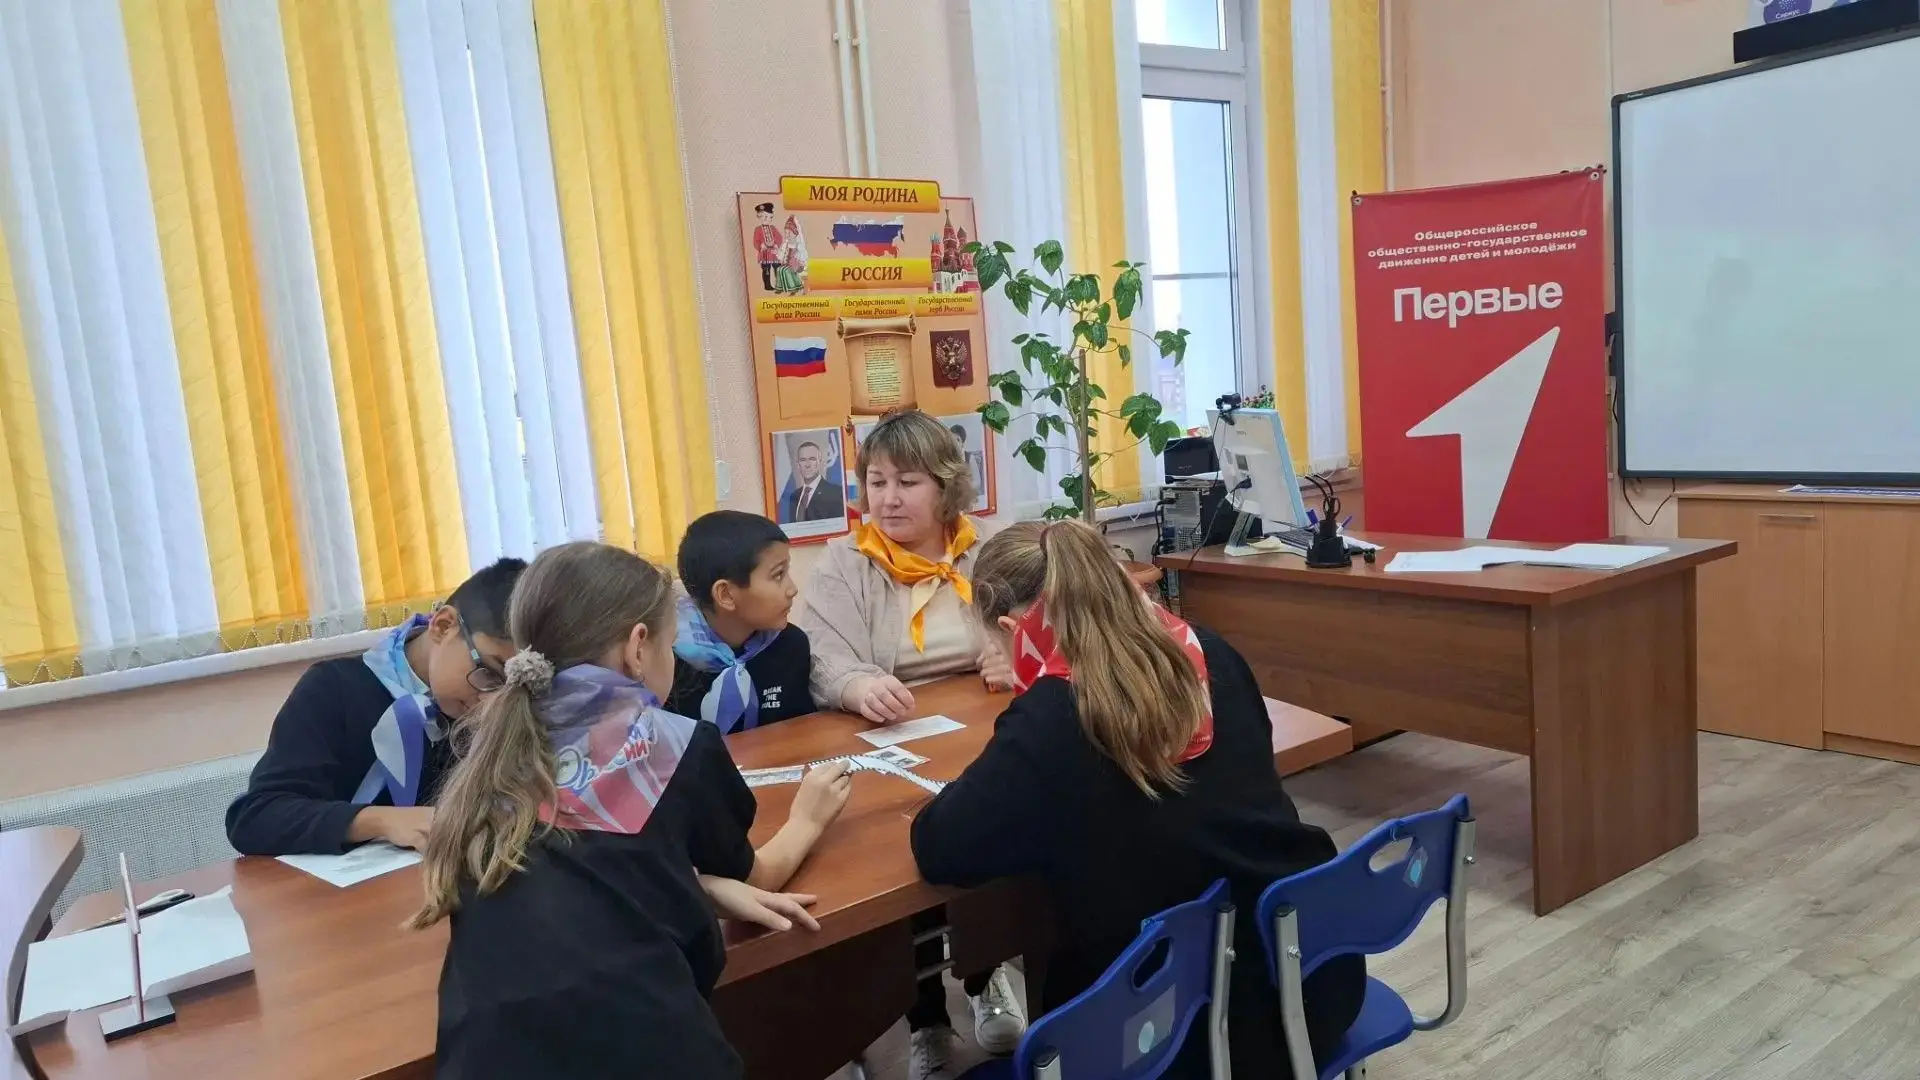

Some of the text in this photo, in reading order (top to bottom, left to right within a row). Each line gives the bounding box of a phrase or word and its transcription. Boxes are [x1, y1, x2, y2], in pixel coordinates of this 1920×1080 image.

[808, 185, 919, 205] МОЯ РОДИНА
[1414, 221, 1538, 241] Общероссийское
[1368, 228, 1588, 258] общественно-государственное
[1378, 240, 1577, 270] движение детей и молодёжи
[841, 266, 904, 282] РОССИЯ
[762, 300, 830, 311] Государственный
[844, 298, 906, 308] Государственный
[1393, 281, 1564, 328] Первые
[774, 311, 821, 320] флаг России
